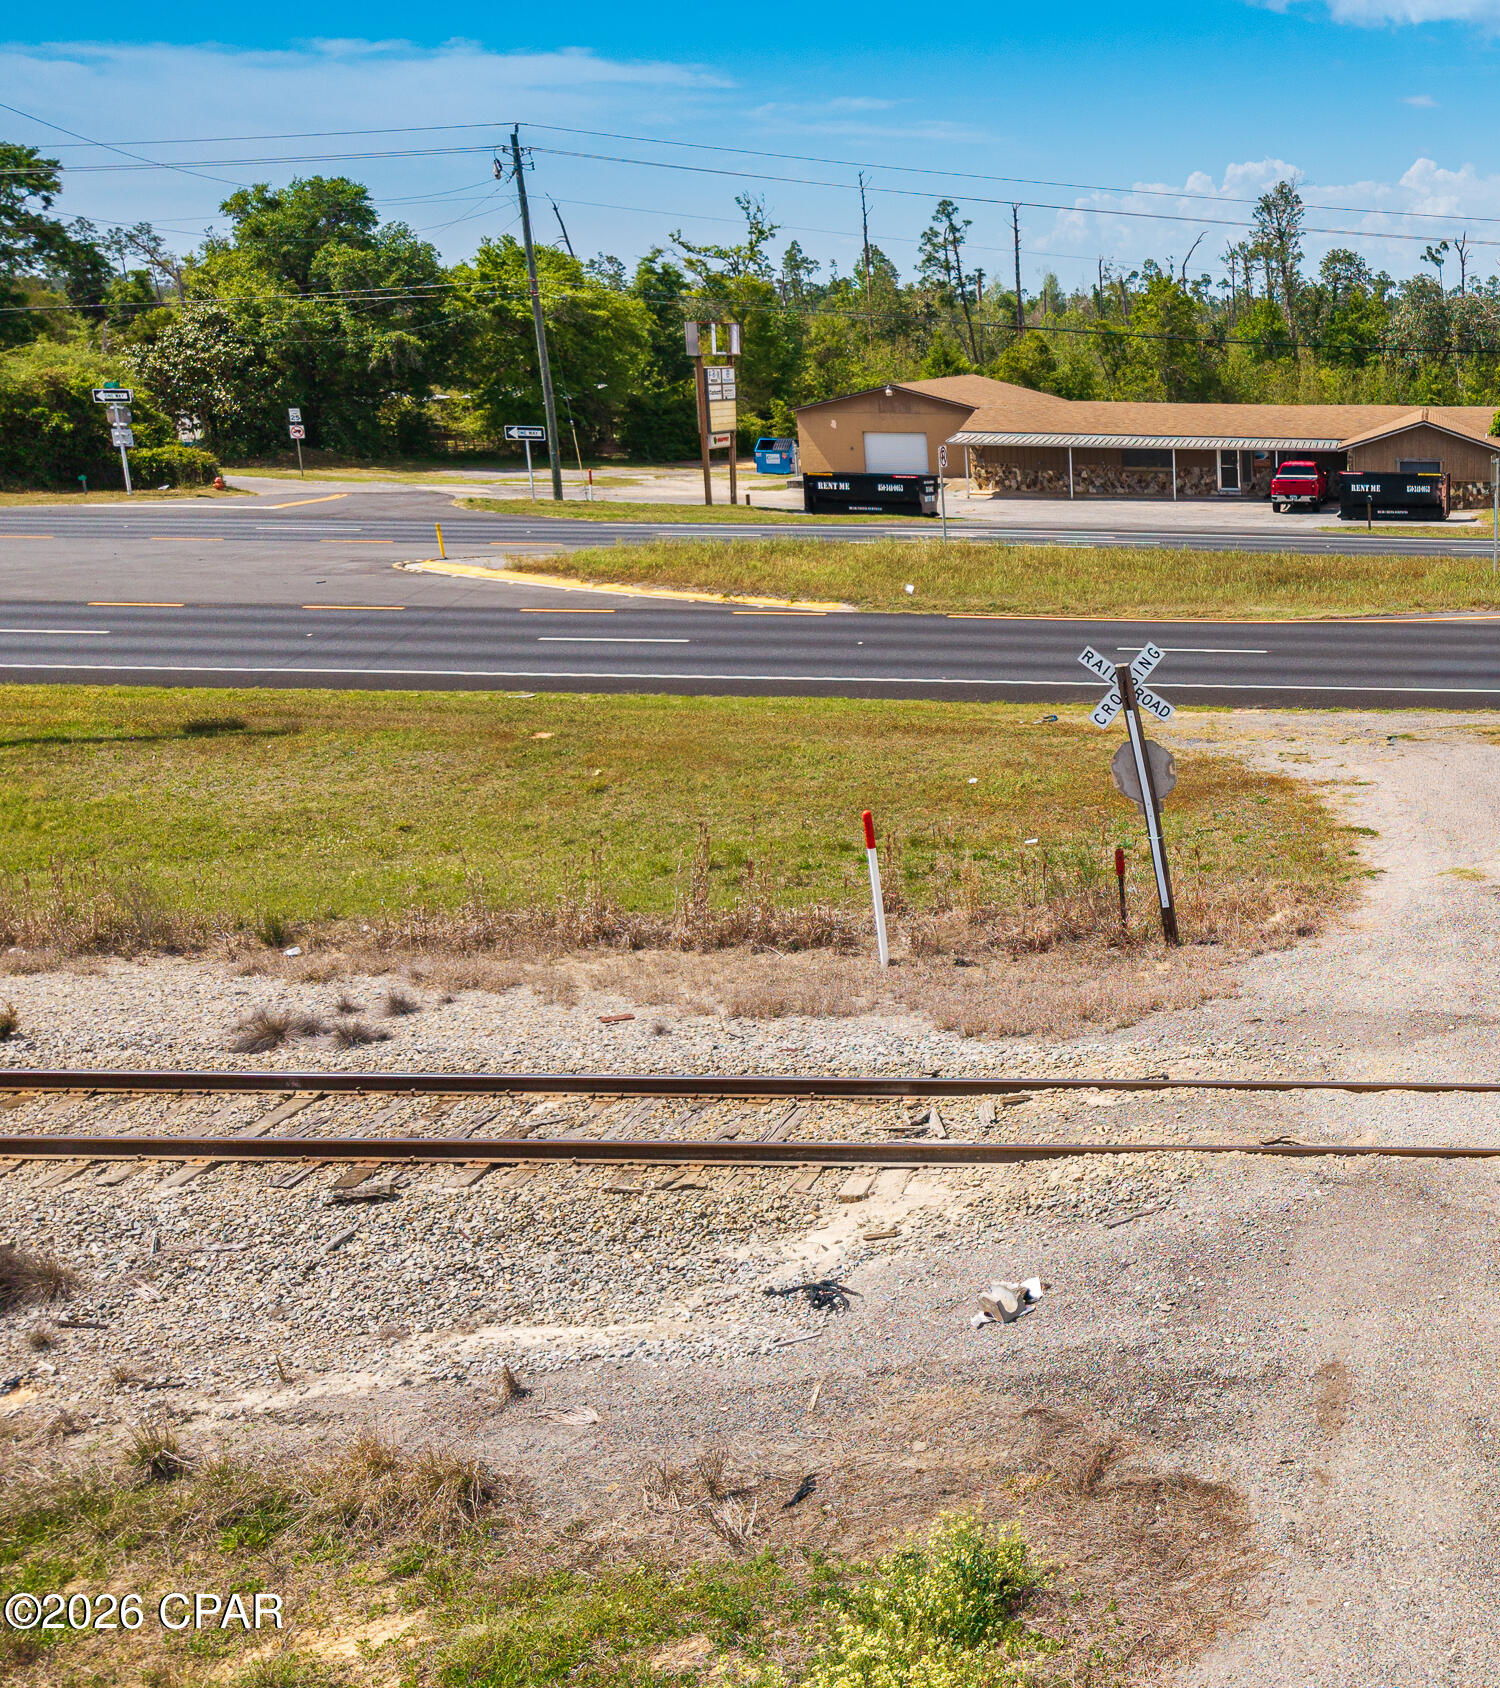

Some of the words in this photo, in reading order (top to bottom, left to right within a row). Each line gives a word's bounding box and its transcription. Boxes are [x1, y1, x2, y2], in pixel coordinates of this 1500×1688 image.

[817, 481, 838, 490] RENT
[839, 482, 851, 491] ME
[1351, 484, 1370, 492] RENT
[1370, 484, 1381, 492] ME
[1081, 650, 1117, 685] RAIL
[1134, 687, 1171, 717] ROAD
[1094, 647, 1160, 725] CROING
